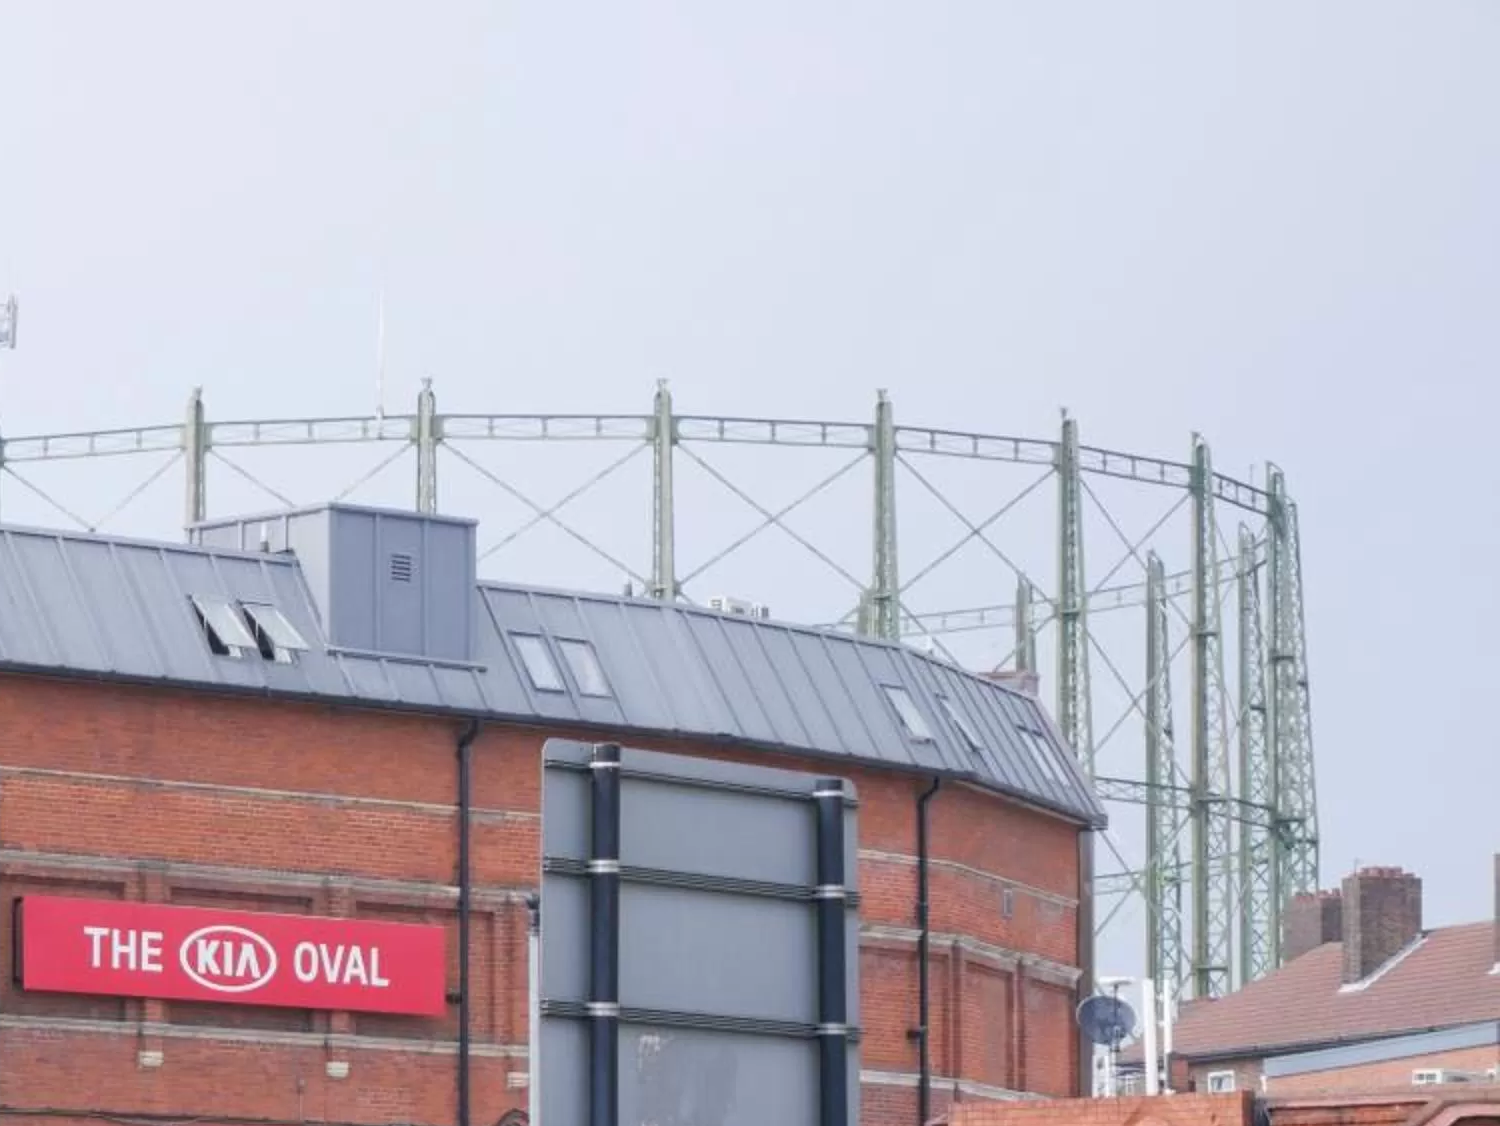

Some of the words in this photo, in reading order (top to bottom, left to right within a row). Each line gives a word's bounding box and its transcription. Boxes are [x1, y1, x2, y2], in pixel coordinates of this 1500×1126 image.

[84, 926, 163, 972] THE
[196, 939, 261, 979] KIA
[294, 942, 390, 987] OVAL
